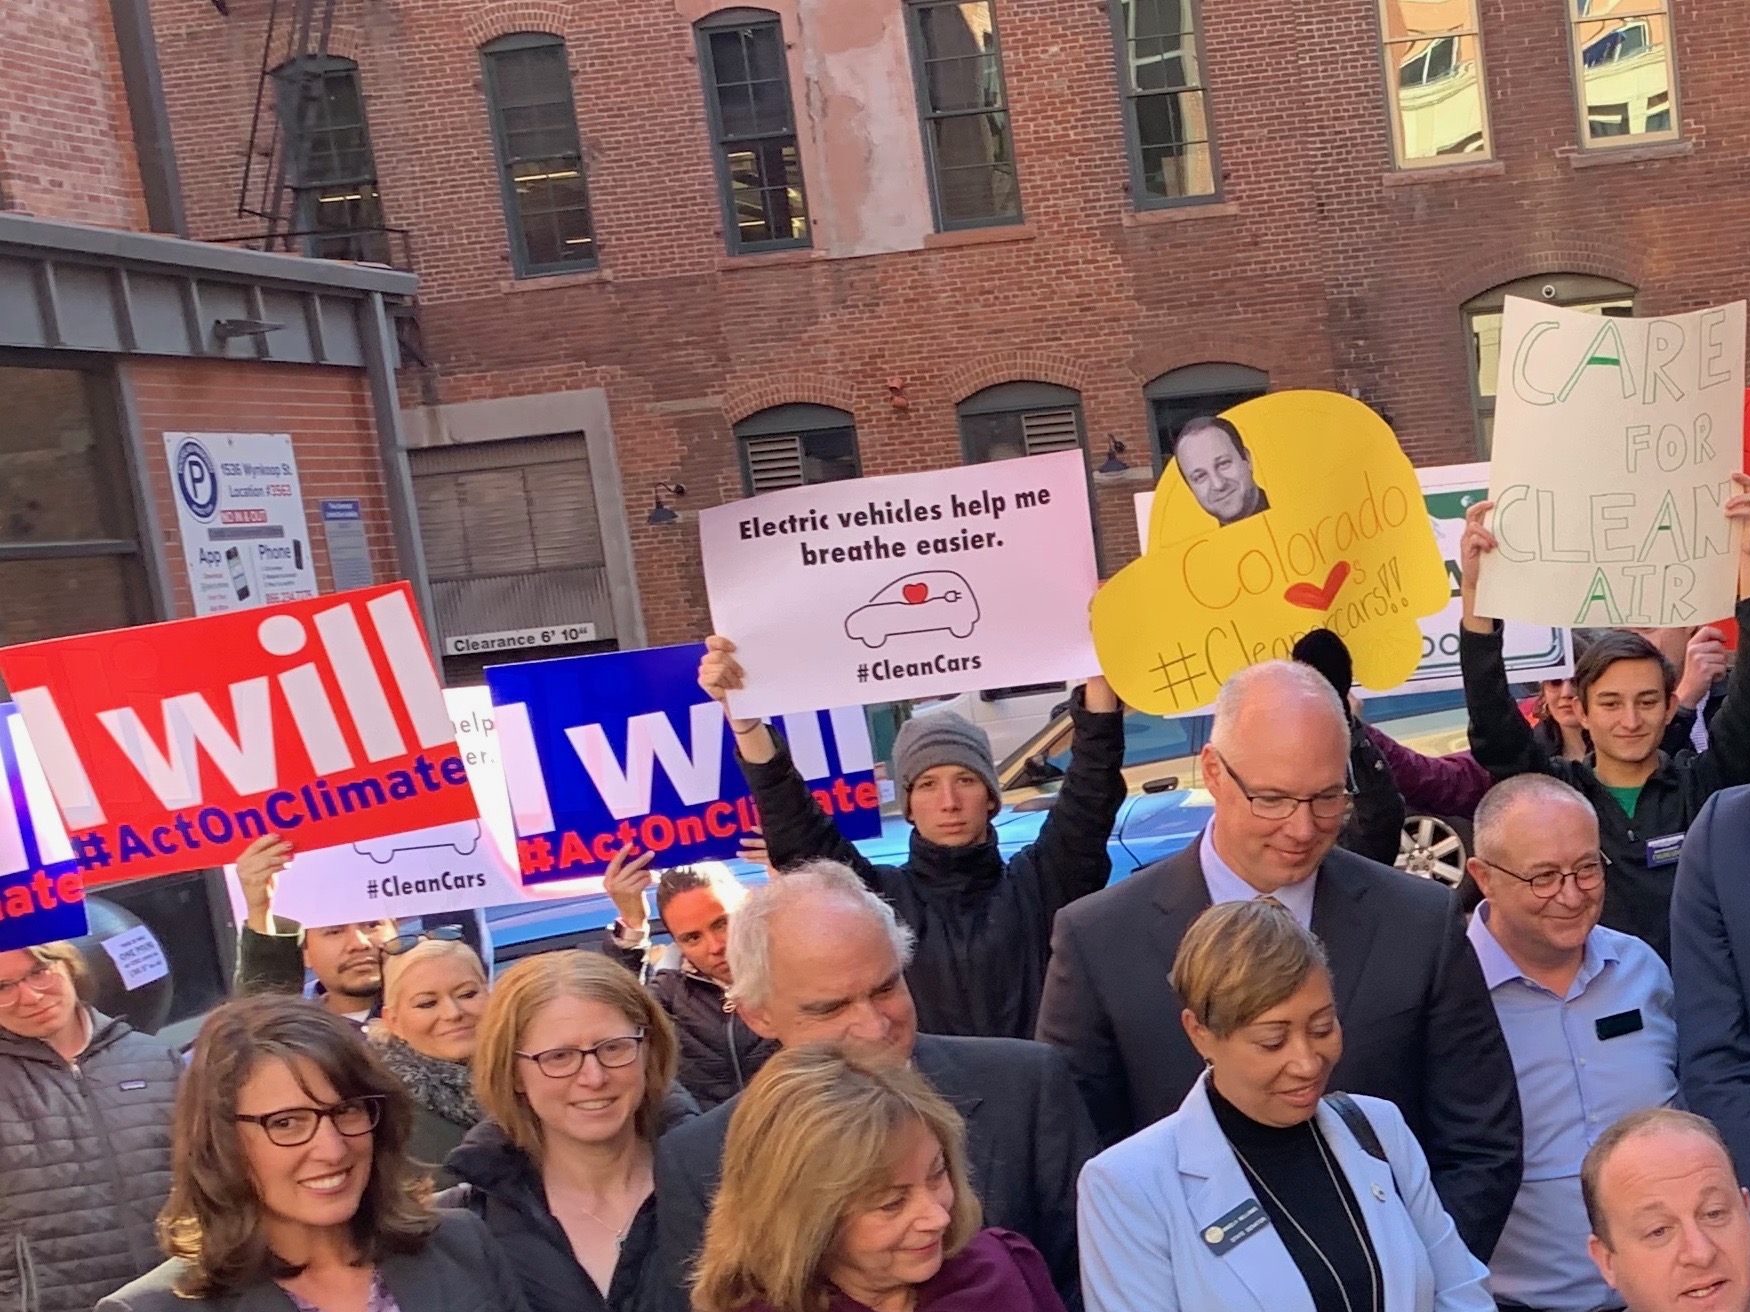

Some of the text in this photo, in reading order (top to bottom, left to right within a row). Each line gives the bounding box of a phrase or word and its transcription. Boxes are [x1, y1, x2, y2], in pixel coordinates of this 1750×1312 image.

[1512, 308, 1731, 406] CARE
[1625, 412, 1716, 473] FOR
[739, 487, 1051, 541] Electric vehicles help me
[1183, 470, 1409, 610] Colorado
[1492, 478, 1732, 564] CLEAN
[801, 529, 1004, 567] breathe easier.
[1573, 563, 1698, 626] AIR
[453, 633, 536, 652] Clearance
[856, 653, 982, 683] #CleanCars
[11, 685, 108, 832] I
[97, 590, 456, 811] will
[492, 702, 556, 837] I
[71, 754, 470, 871] #ActOnClimate
[366, 870, 487, 899] #CleanCars
